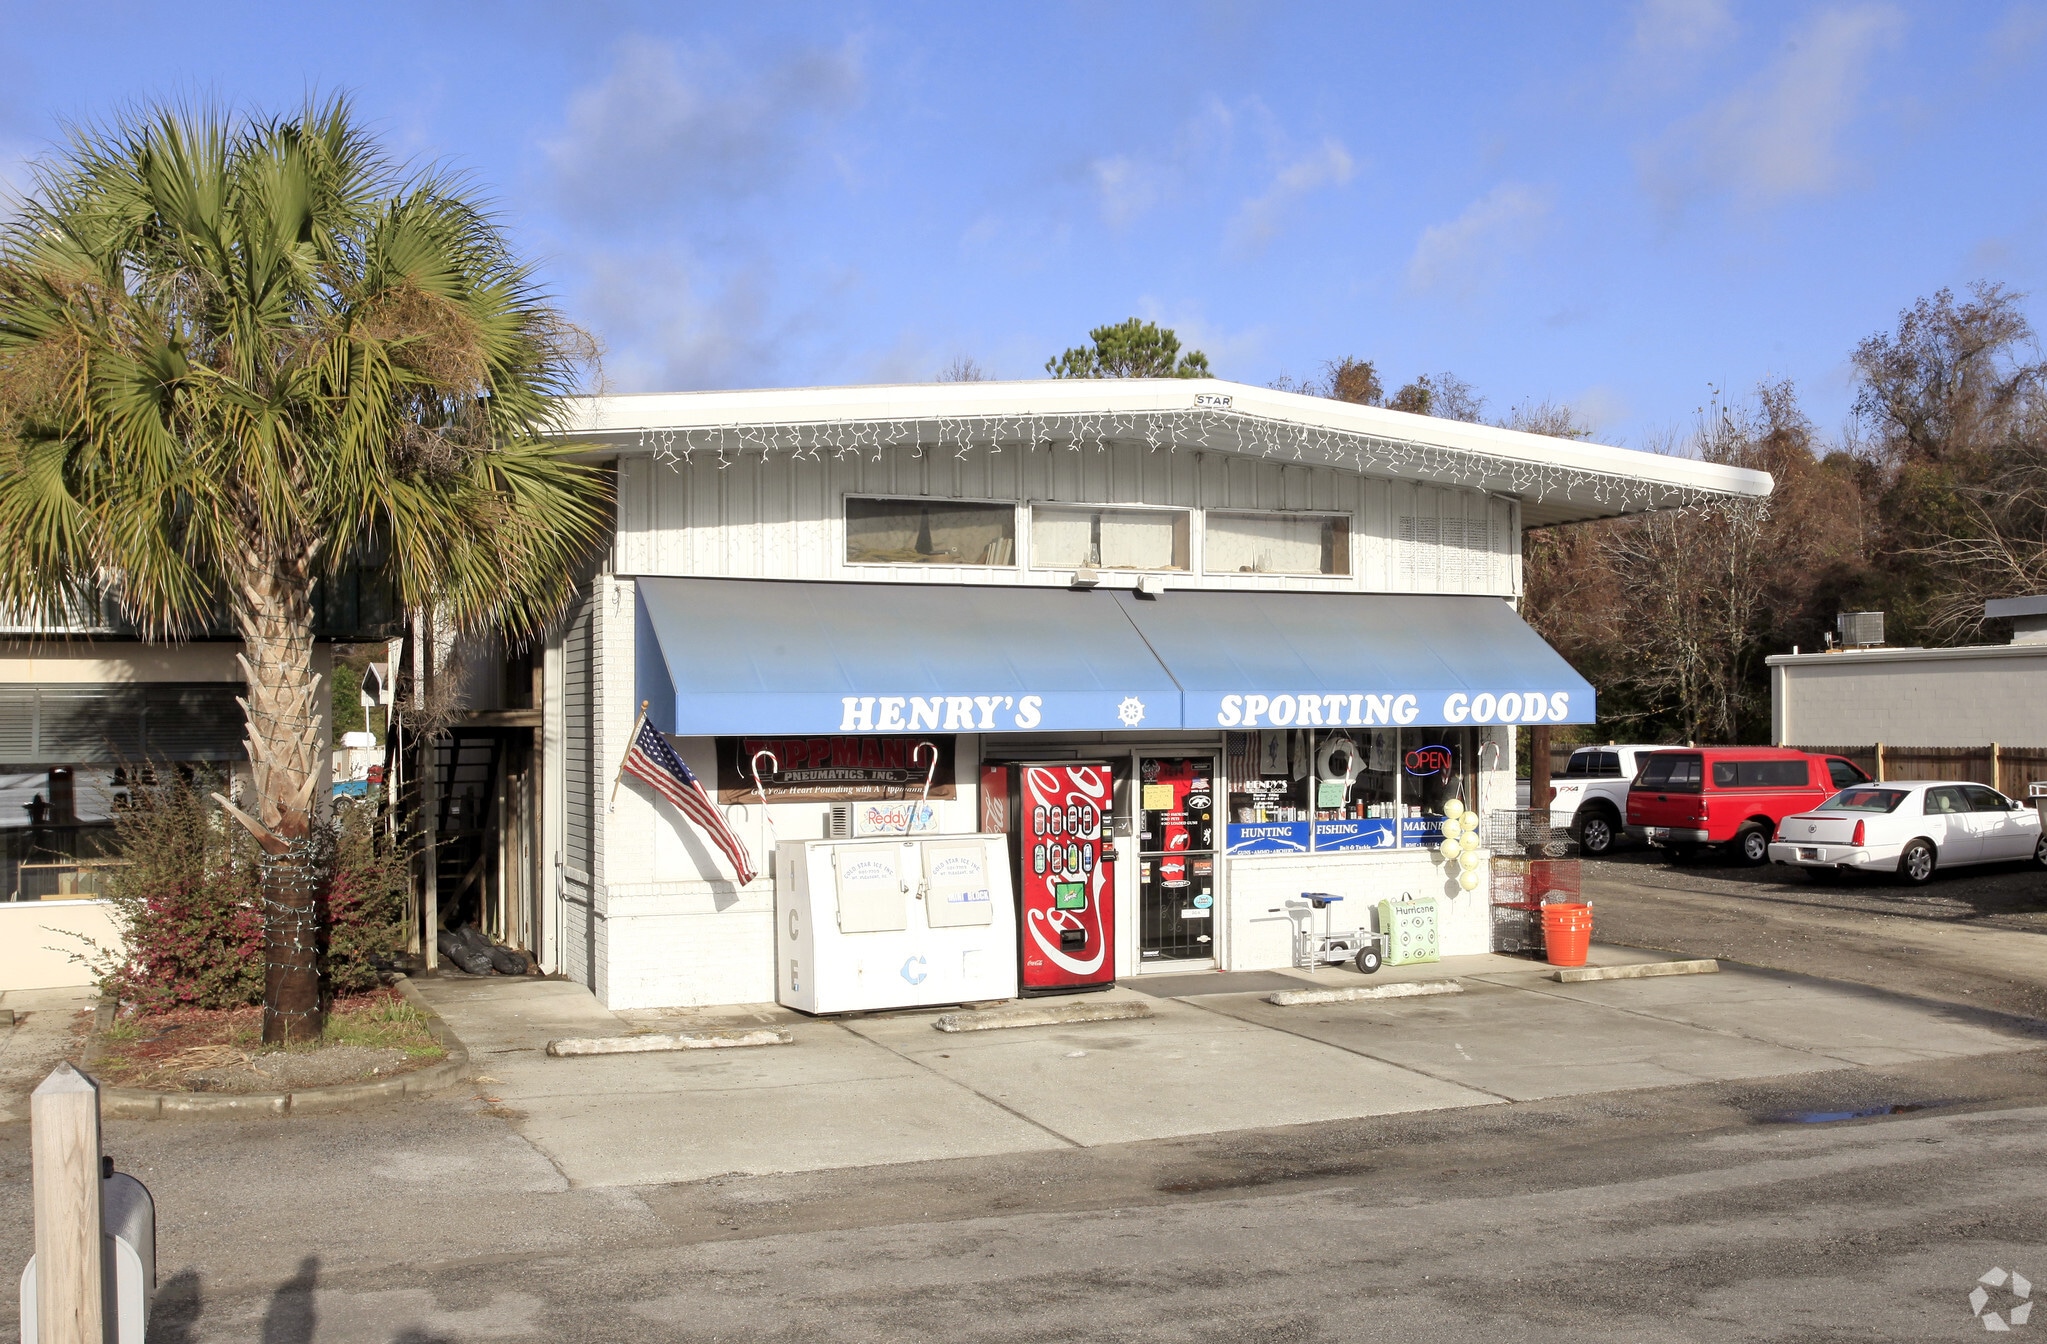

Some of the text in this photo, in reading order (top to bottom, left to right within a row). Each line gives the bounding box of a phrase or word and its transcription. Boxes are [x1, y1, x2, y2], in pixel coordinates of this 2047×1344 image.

[1196, 395, 1231, 406] STAR
[839, 695, 1043, 731] HENRY'S
[1217, 691, 1570, 727] SPORTING GOODS
[743, 736, 928, 771] TIPPMANN
[1405, 751, 1450, 769] OPEN
[784, 769, 898, 782] PNEUMATICS, INC.
[1245, 780, 1288, 789] HENRY'S
[750, 787, 766, 796] Gt
[768, 787, 788, 795] Your
[789, 786, 812, 795] Heart
[814, 785, 853, 796] Pounding
[855, 785, 872, 793] with
[873, 785, 880, 793] A
[868, 810, 909, 827] Reddy
[1316, 824, 1359, 835] FISHING
[1403, 821, 1444, 831] MARINE
[1240, 826, 1292, 838] HUNTING
[857, 861, 872, 869] STAR
[873, 861, 882, 869] ICE
[945, 857, 959, 865] STAR
[960, 857, 970, 865] ICE
[1395, 905, 1435, 915] Hurricane
[788, 860, 799, 992] ICE
